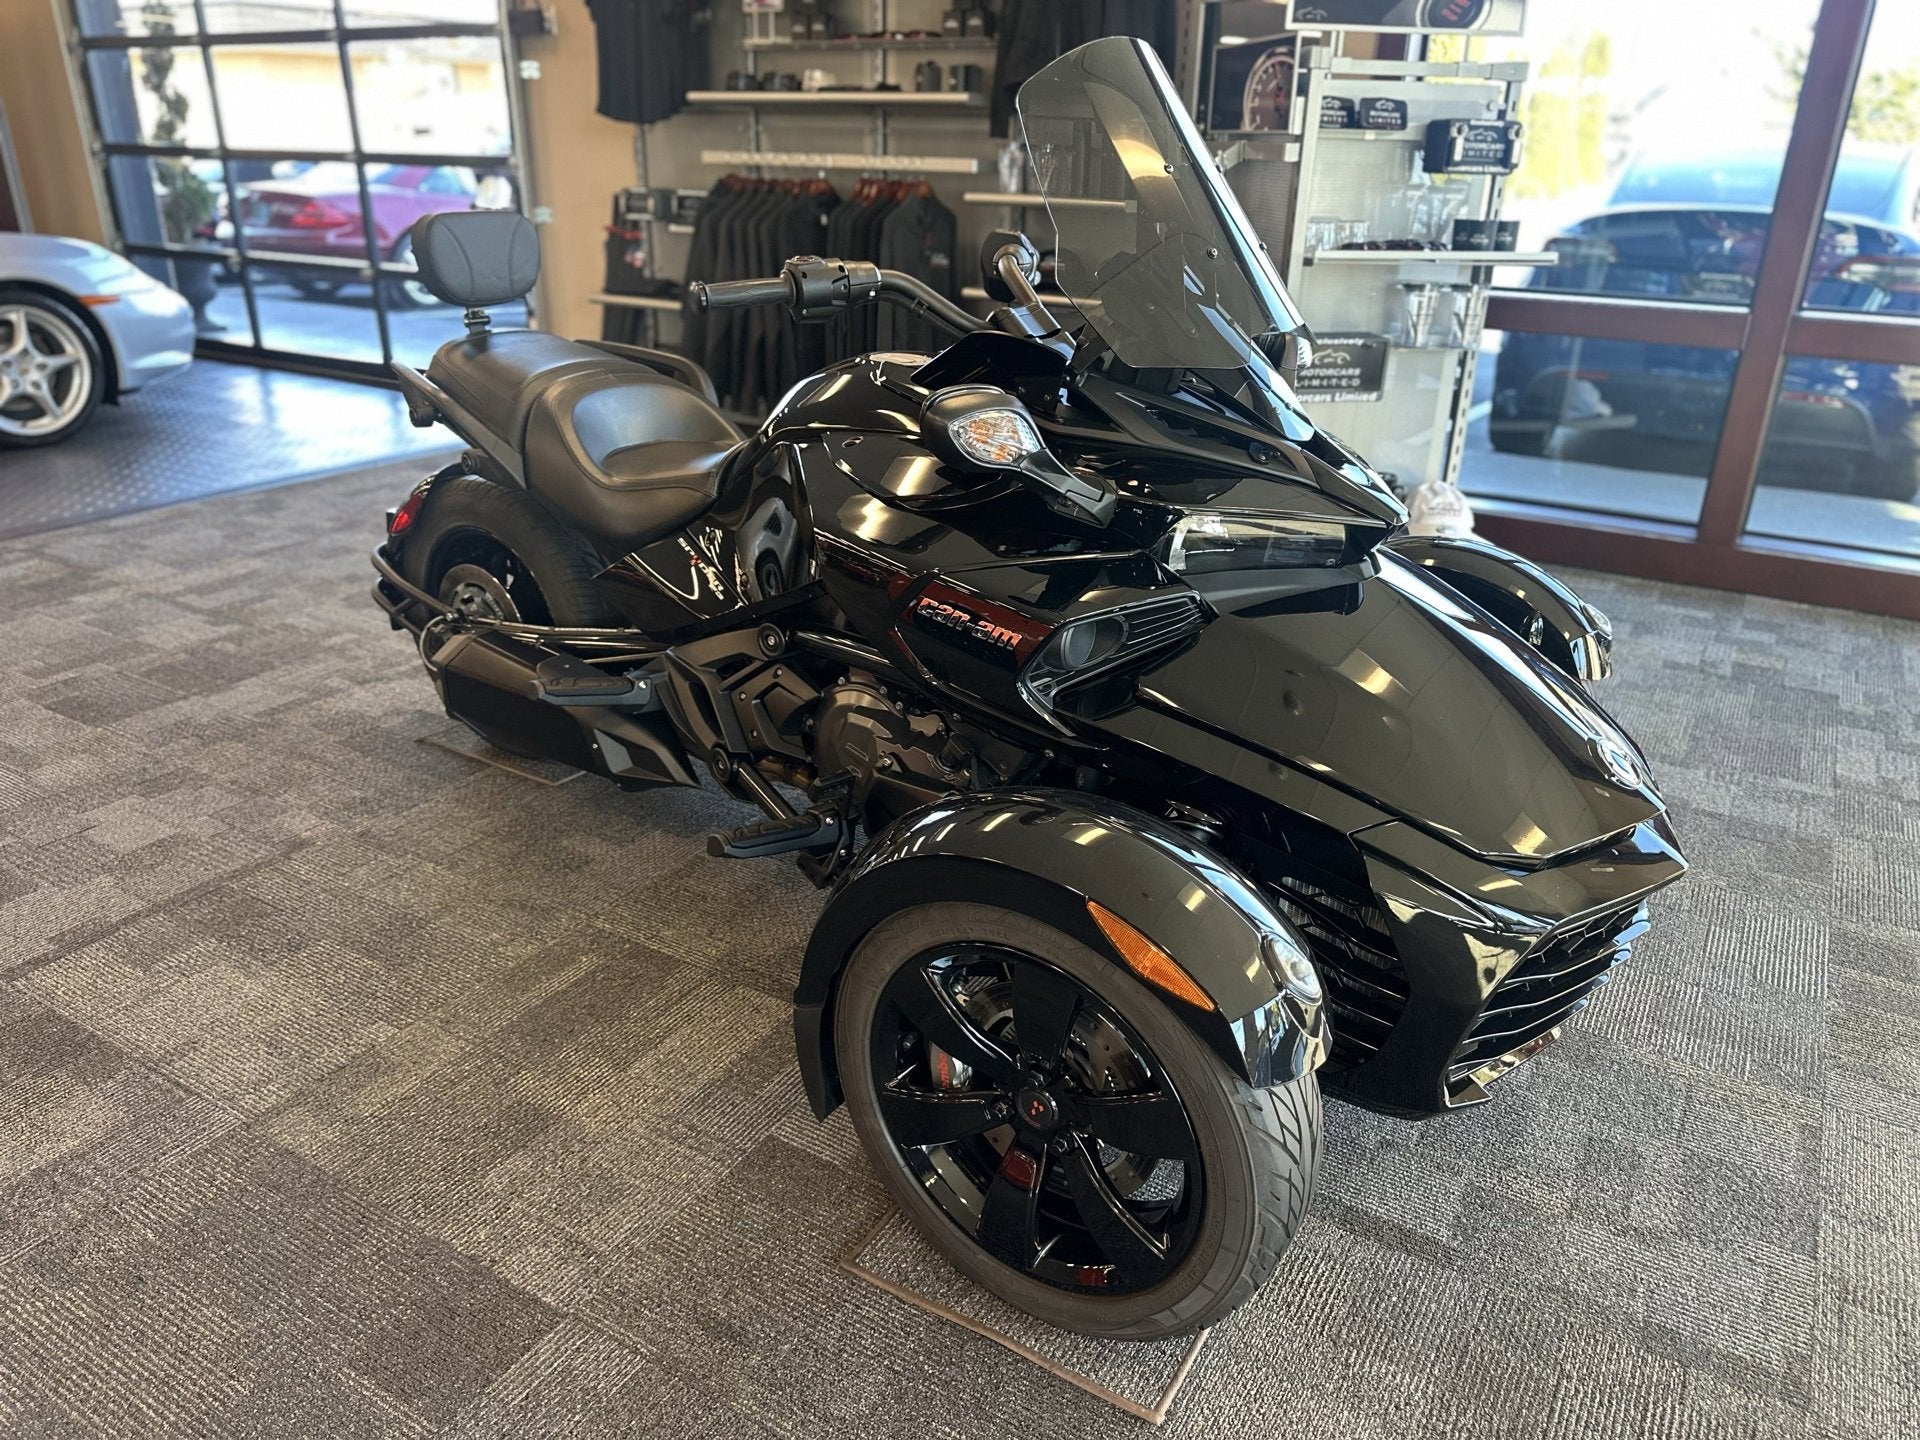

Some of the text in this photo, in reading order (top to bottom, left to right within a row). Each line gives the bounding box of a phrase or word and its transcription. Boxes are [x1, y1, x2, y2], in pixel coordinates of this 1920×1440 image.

[1464, 141, 1505, 151] OTORCARS
[1463, 150, 1504, 159] IMITED
[1315, 337, 1364, 346] clusively
[1296, 391, 1378, 402] orcars Limited
[917, 597, 1023, 651] can-am
[938, 1052, 950, 1089] embo
